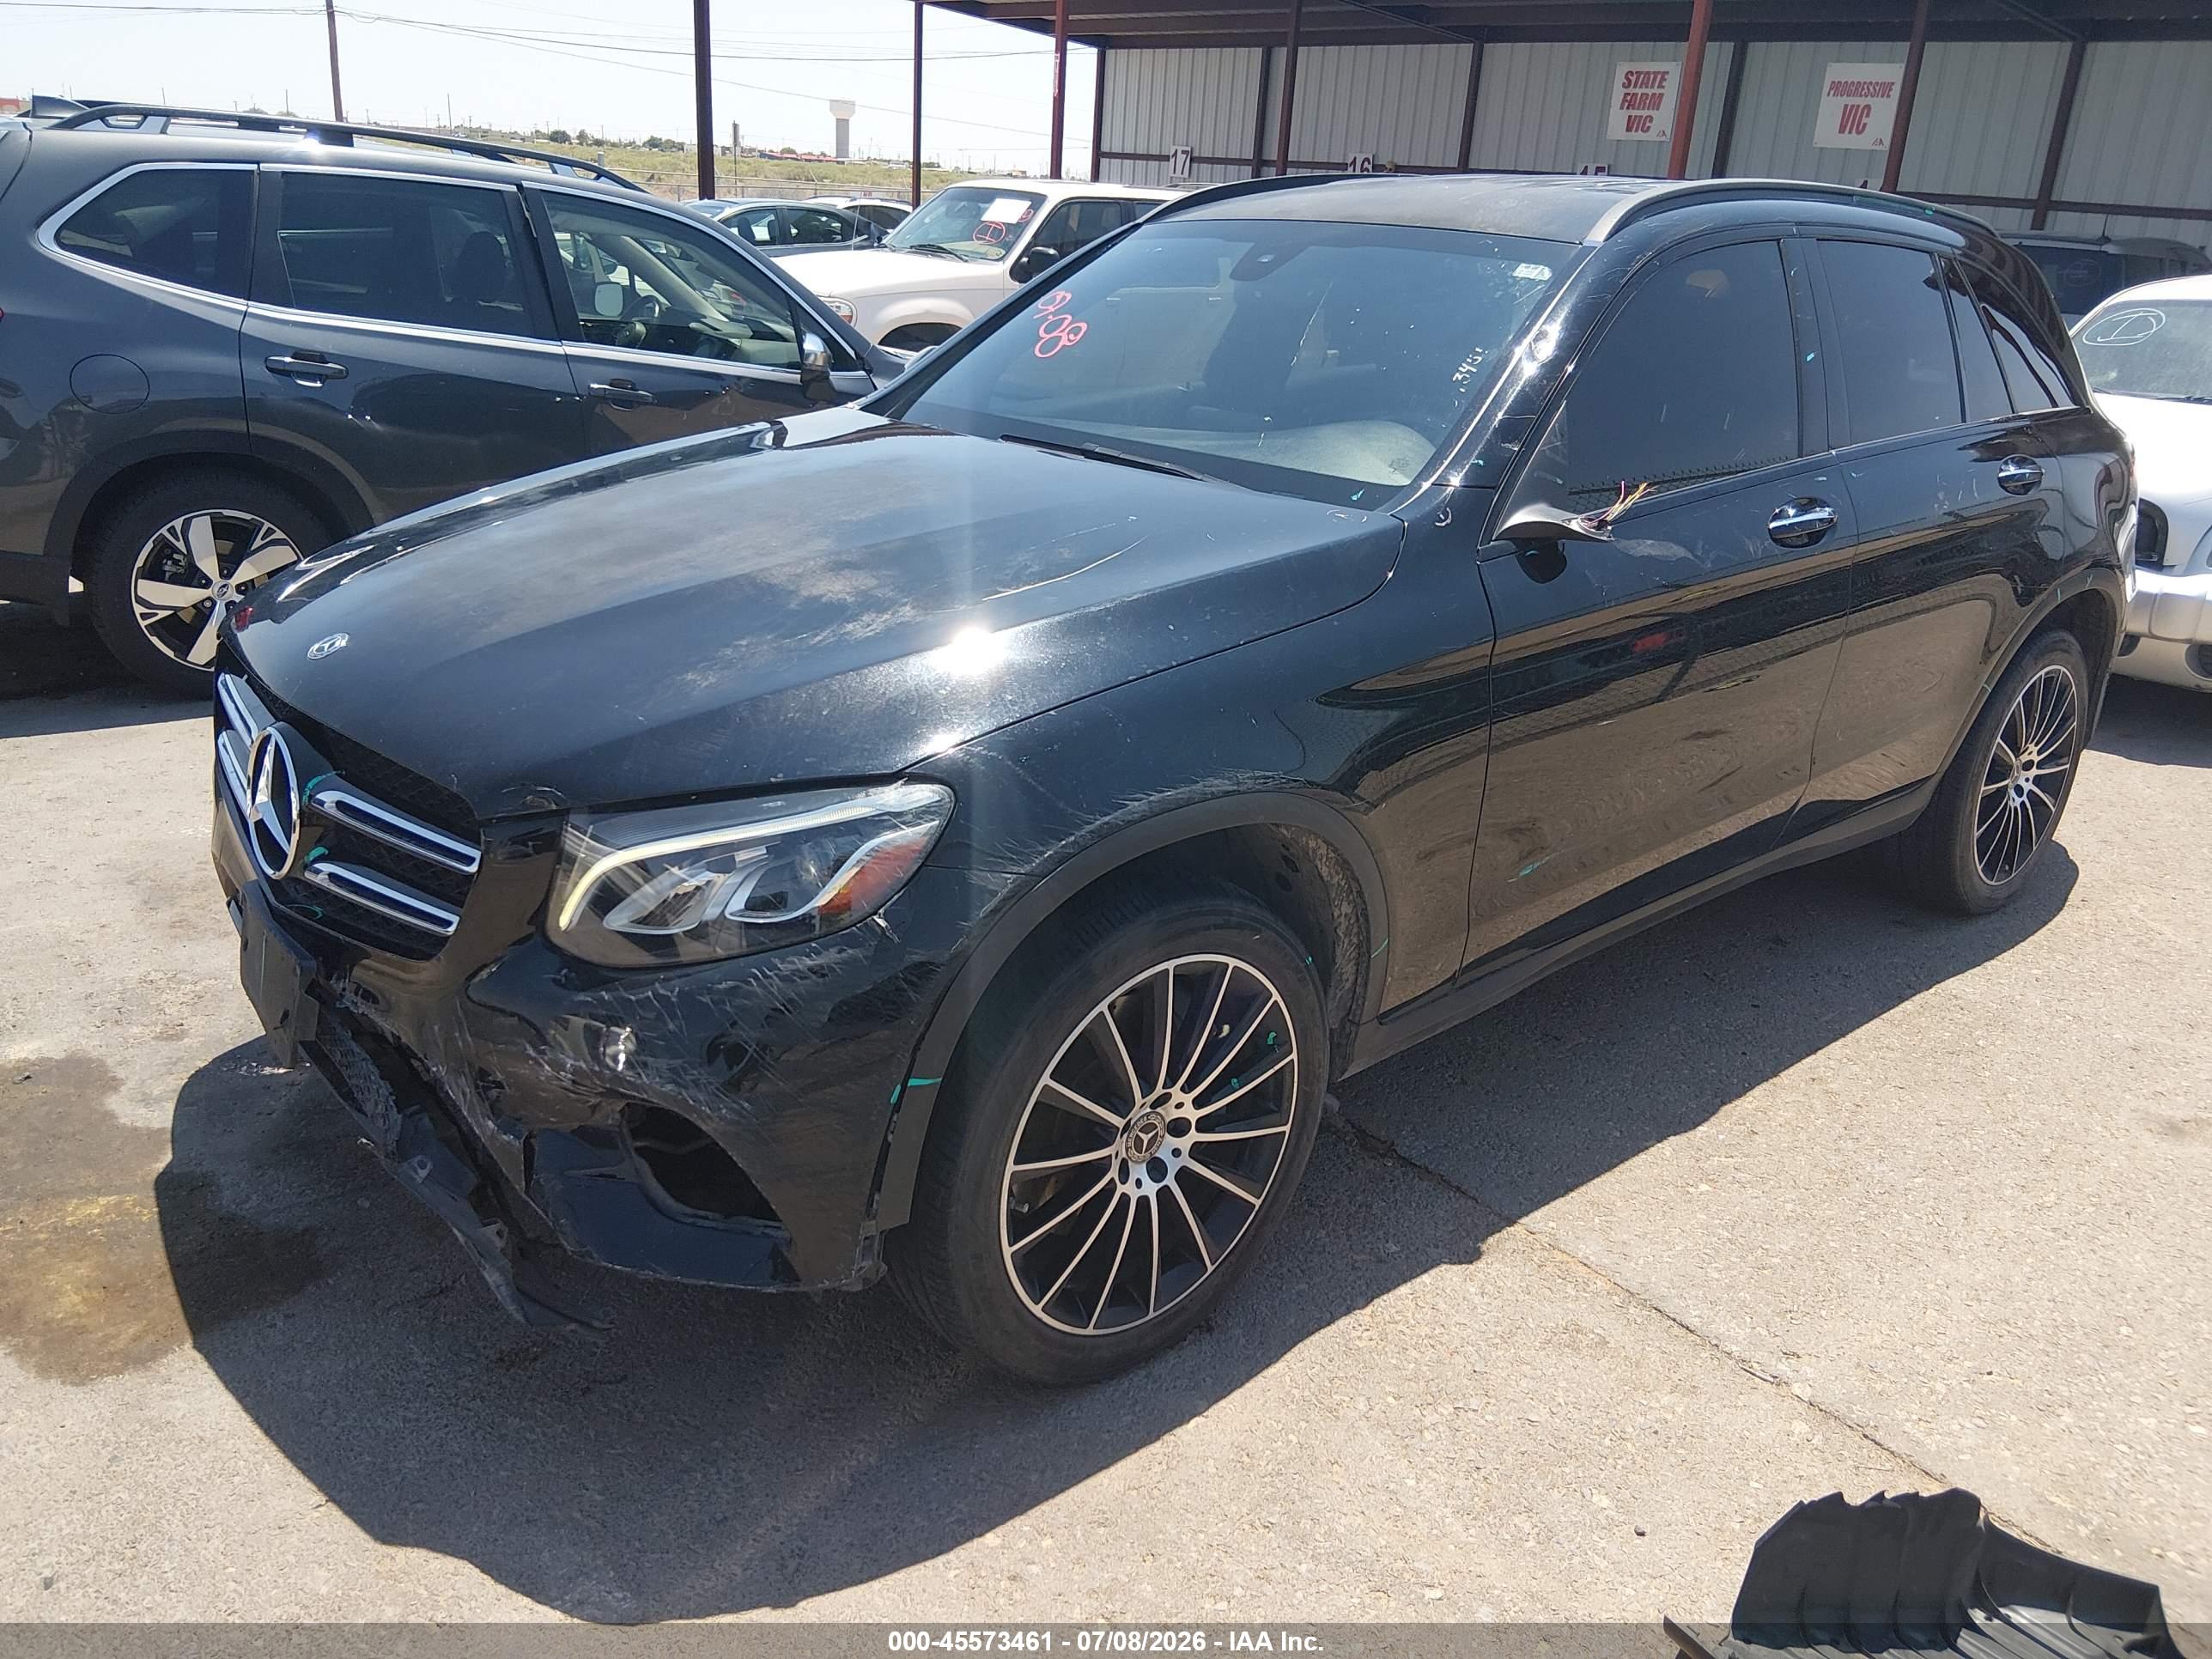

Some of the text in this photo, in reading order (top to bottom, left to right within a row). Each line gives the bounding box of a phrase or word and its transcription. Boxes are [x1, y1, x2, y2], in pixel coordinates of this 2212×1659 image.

[1622, 70, 1669, 89] STATE
[1826, 81, 1896, 98] PROGRESSIVE
[1619, 92, 1664, 111] FARM
[1626, 114, 1654, 133] VIC
[1838, 104, 1872, 135] VIC
[1171, 149, 1190, 175] 17
[1349, 156, 1371, 173] 16
